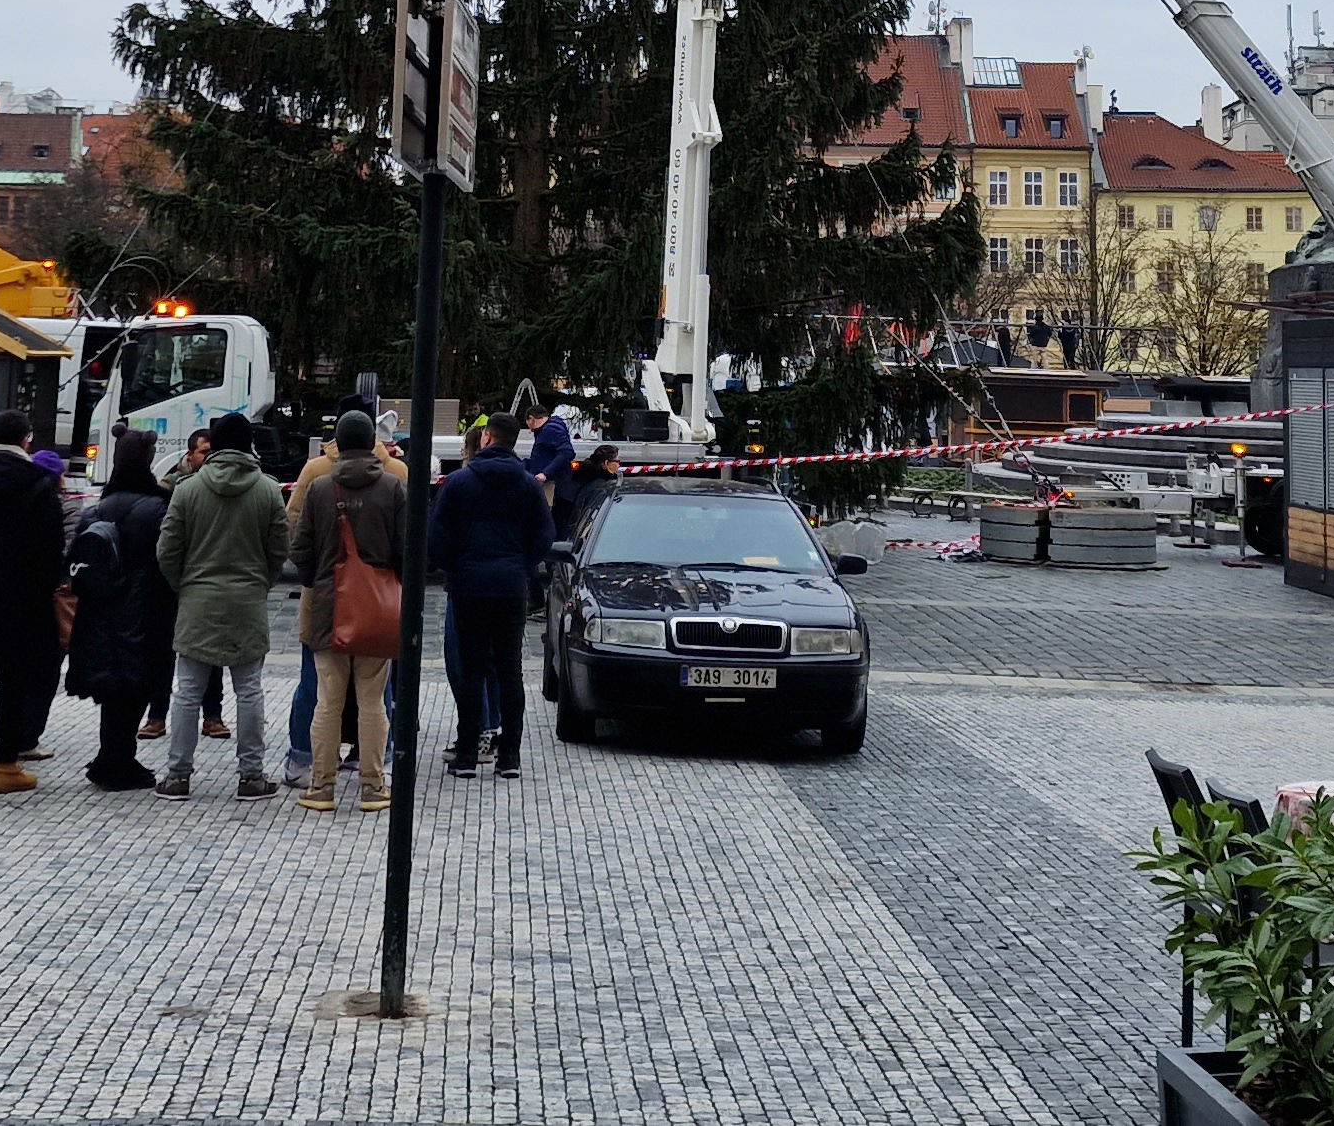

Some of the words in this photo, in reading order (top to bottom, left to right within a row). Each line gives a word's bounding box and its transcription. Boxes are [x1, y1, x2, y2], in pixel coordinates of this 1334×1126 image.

[1241, 46, 1284, 96] strach
[674, 148, 681, 168] 60
[673, 174, 680, 195] 40
[672, 199, 679, 220] 40
[693, 668, 721, 685] 3A9
[733, 669, 771, 686] 3014
